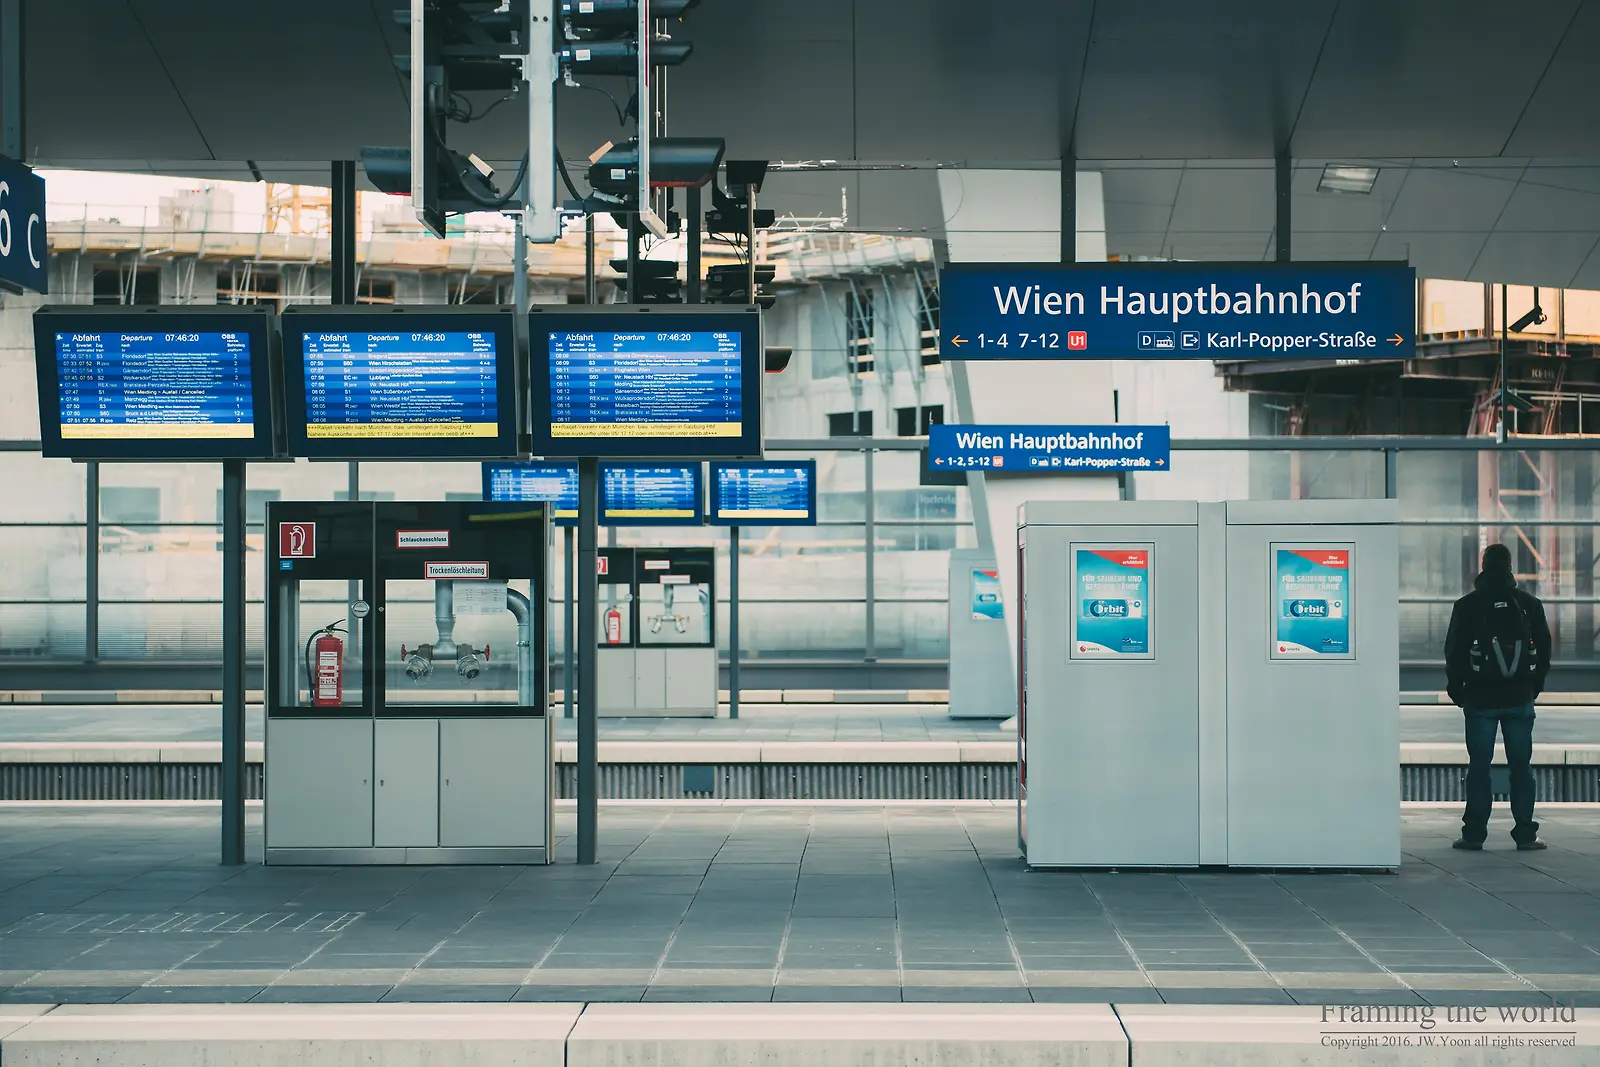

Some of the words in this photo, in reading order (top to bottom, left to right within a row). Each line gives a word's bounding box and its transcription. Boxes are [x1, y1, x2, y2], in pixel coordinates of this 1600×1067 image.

[28, 213, 40, 268] C
[993, 284, 1085, 315] Wien
[1100, 282, 1362, 322] Hauptbahnhof
[977, 333, 1008, 348] 1-4
[1018, 333, 1060, 348] 7-12
[1070, 336, 1084, 346] U1
[1207, 332, 1376, 351] Karl-Popper-Straße
[956, 432, 1004, 449] Wien
[1010, 432, 1144, 453] Hauptbahnhof
[968, 457, 990, 466] 5-12
[1064, 457, 1151, 468] Karl-Popper-Straße
[429, 566, 485, 575] Trockenlöschleitung
[1082, 574, 1095, 582] FÜR
[1282, 574, 1295, 582] FÜR
[1094, 604, 1125, 614] Orbit
[1294, 604, 1325, 614] Orbit
